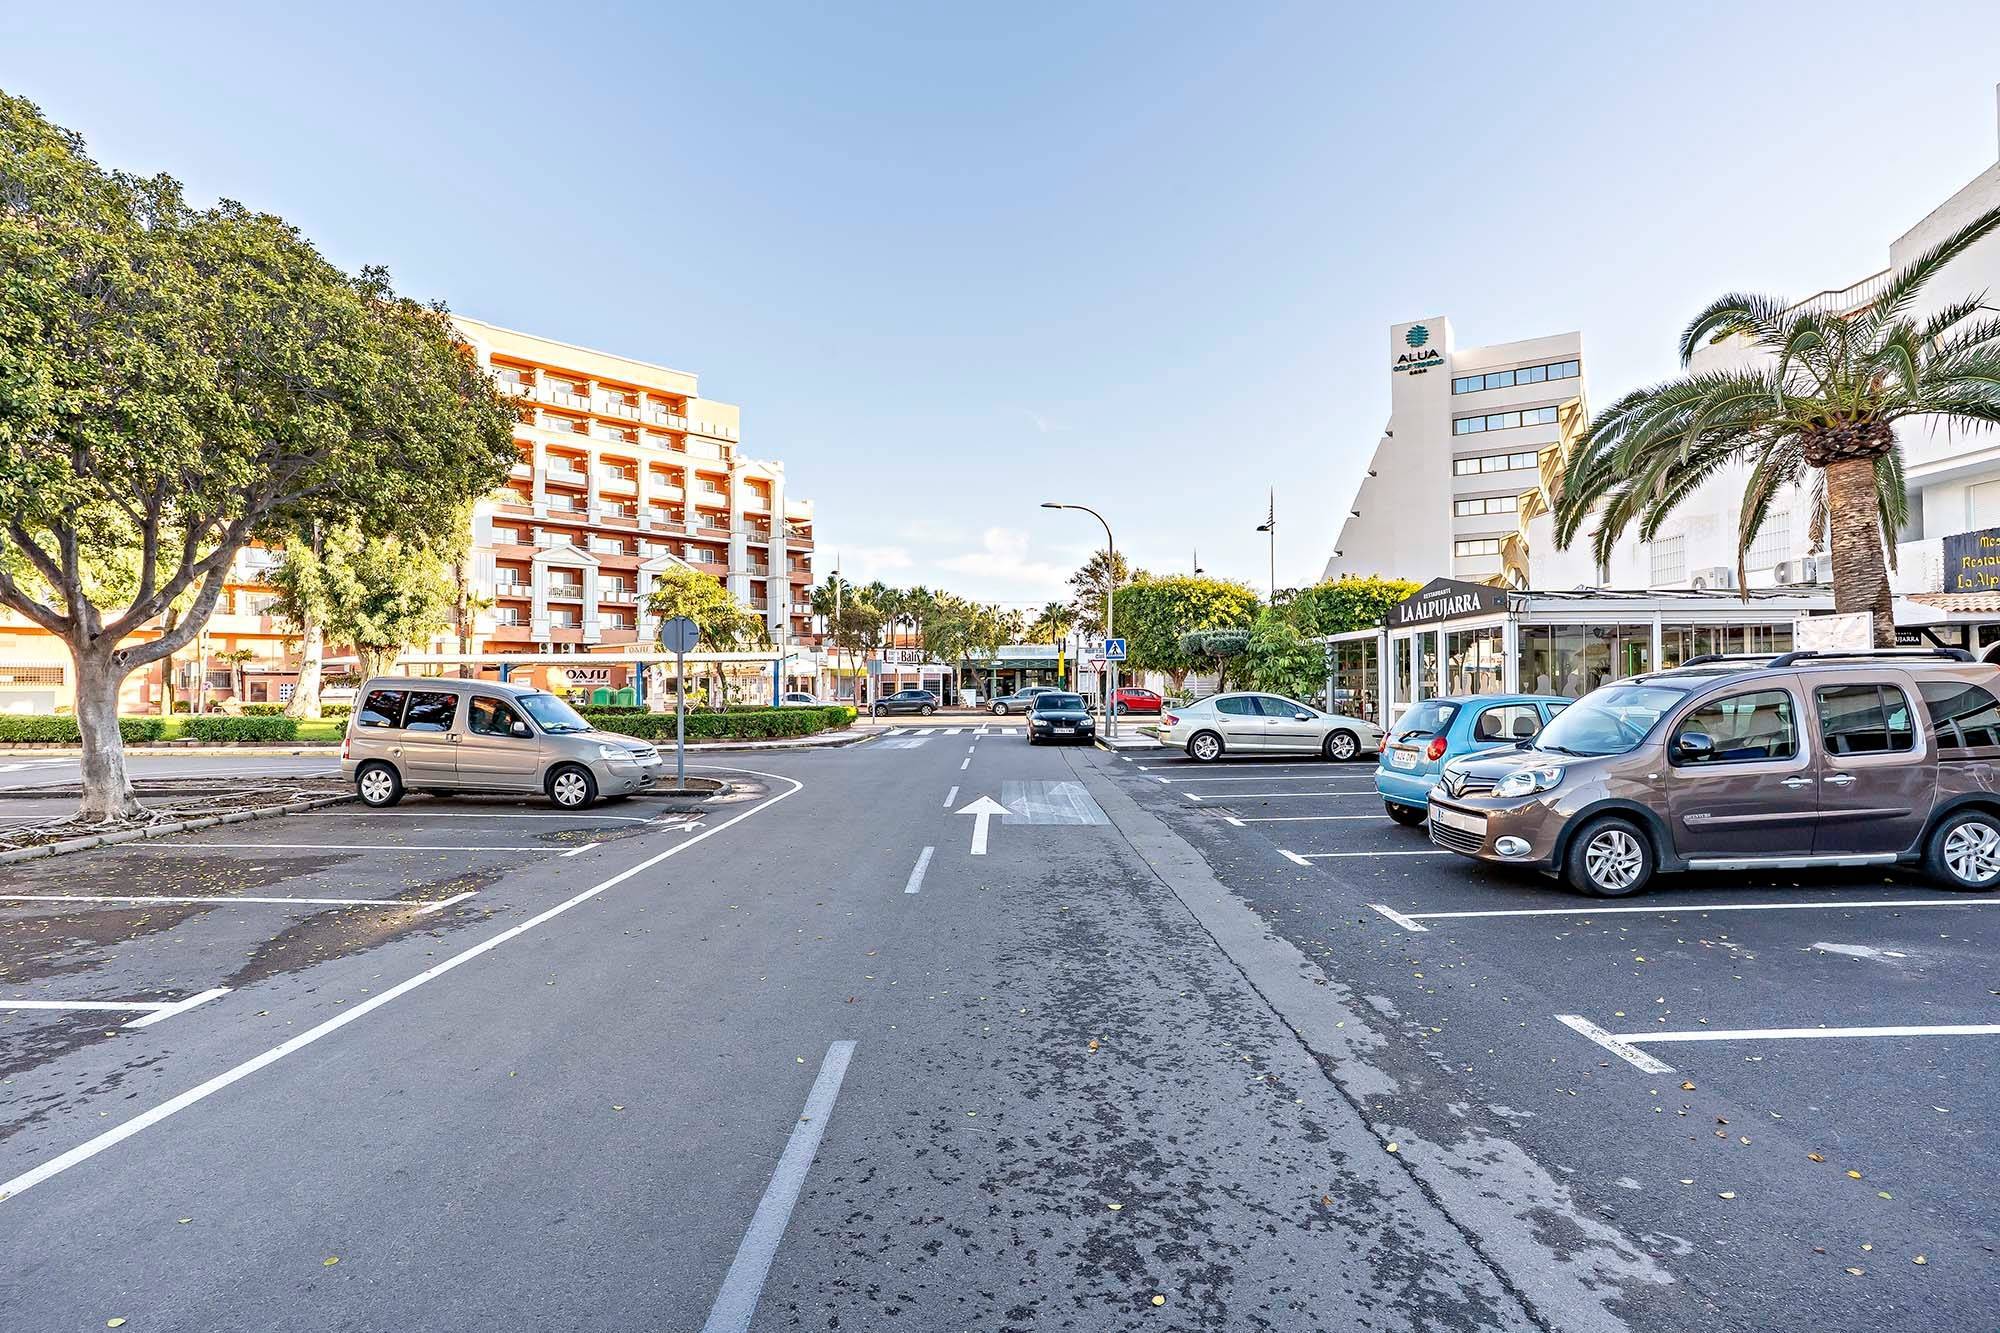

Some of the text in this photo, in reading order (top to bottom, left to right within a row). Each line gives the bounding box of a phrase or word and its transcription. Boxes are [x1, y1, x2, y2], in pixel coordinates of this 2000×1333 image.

[1397, 349, 1439, 364] ALUA
[1957, 574, 1972, 589] La
[1400, 592, 1481, 623] LA ALPUJARRA
[566, 669, 608, 679] OASIS
